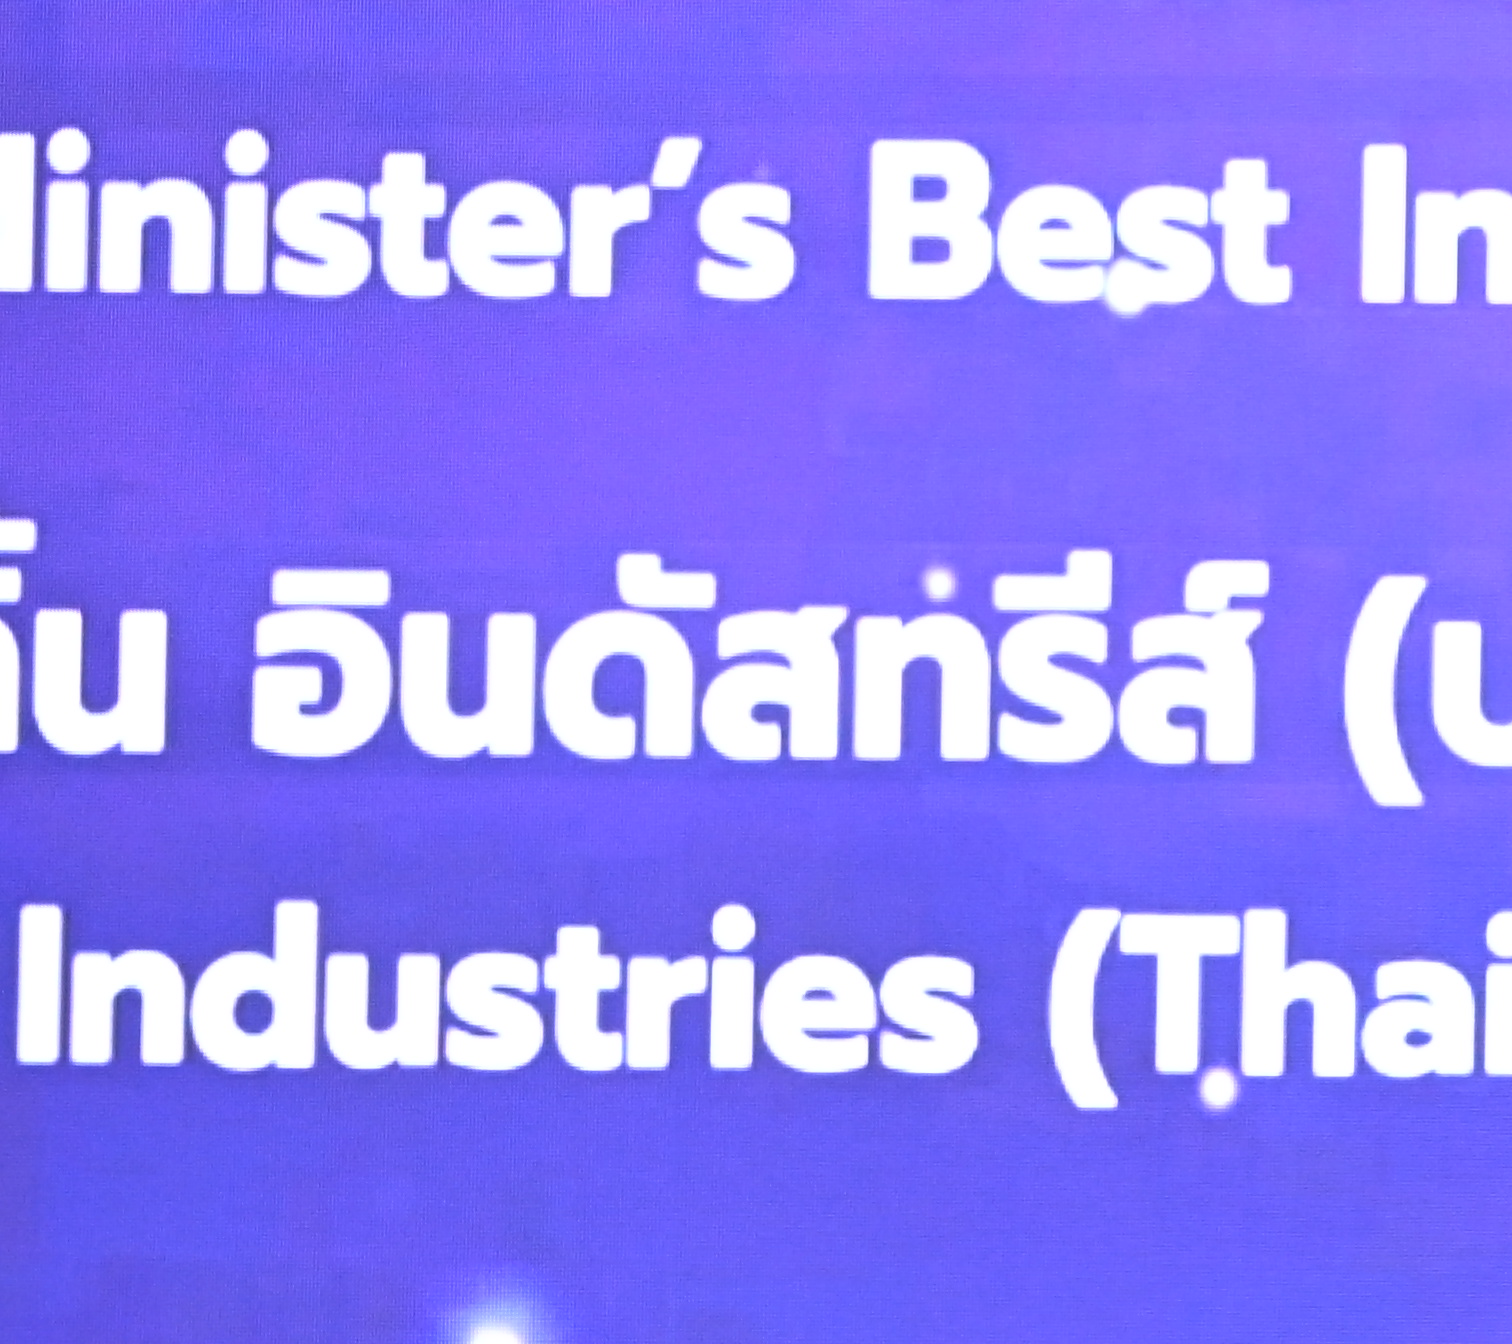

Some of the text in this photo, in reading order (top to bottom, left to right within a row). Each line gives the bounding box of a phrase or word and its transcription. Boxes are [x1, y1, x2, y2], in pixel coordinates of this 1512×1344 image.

[0, 127, 796, 302] inister’s
[868, 139, 1294, 306] Best
[250, 549, 1271, 765] อินดัสทรีส์
[15, 900, 980, 1074] Industries
